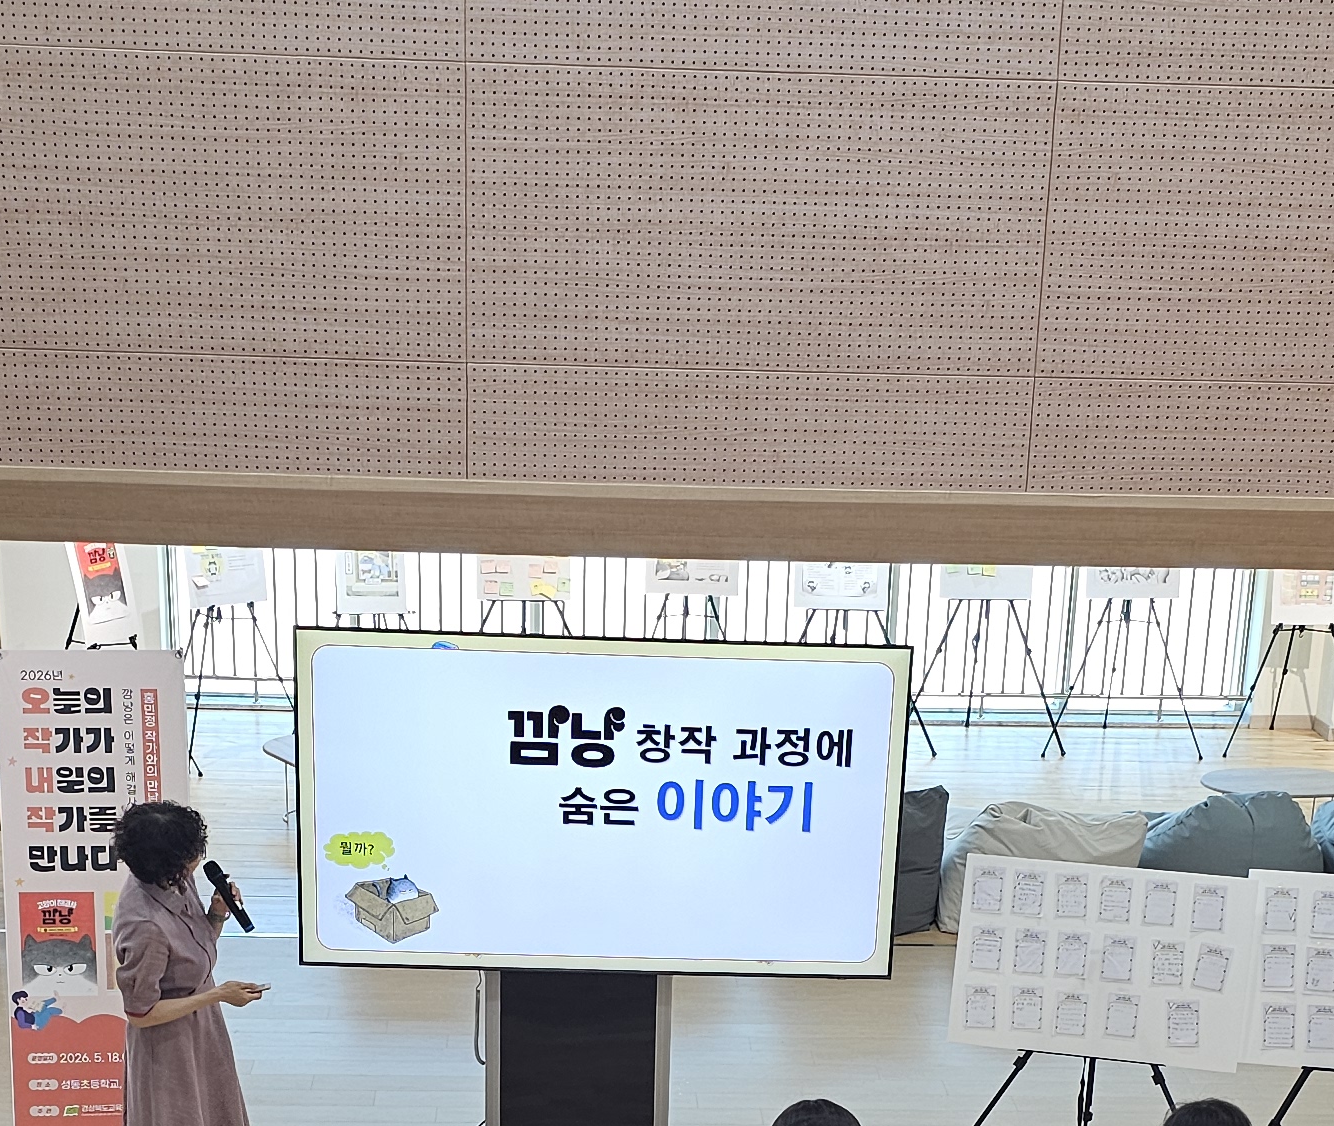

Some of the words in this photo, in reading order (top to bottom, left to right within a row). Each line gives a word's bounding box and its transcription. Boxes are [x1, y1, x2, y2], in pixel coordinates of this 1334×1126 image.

[20, 669, 63, 681] 2026년
[21, 686, 113, 714] 오늘의
[121, 688, 134, 724] 깜냥은
[22, 727, 115, 754] 작가가
[123, 730, 136, 766] 어떻게
[508, 704, 625, 768] 깜냥
[635, 723, 716, 765] 창작
[733, 726, 854, 768] 과정에
[145, 730, 158, 778] 작가와의
[25, 766, 116, 794] 내일의
[27, 806, 117, 833] 작가를
[558, 787, 639, 826] 숨은
[657, 779, 814, 833] 이야기
[41, 908, 74, 925] 깜냥
[60, 1053, 92, 1063] 2026.
[94, 1053, 105, 1063] 5.
